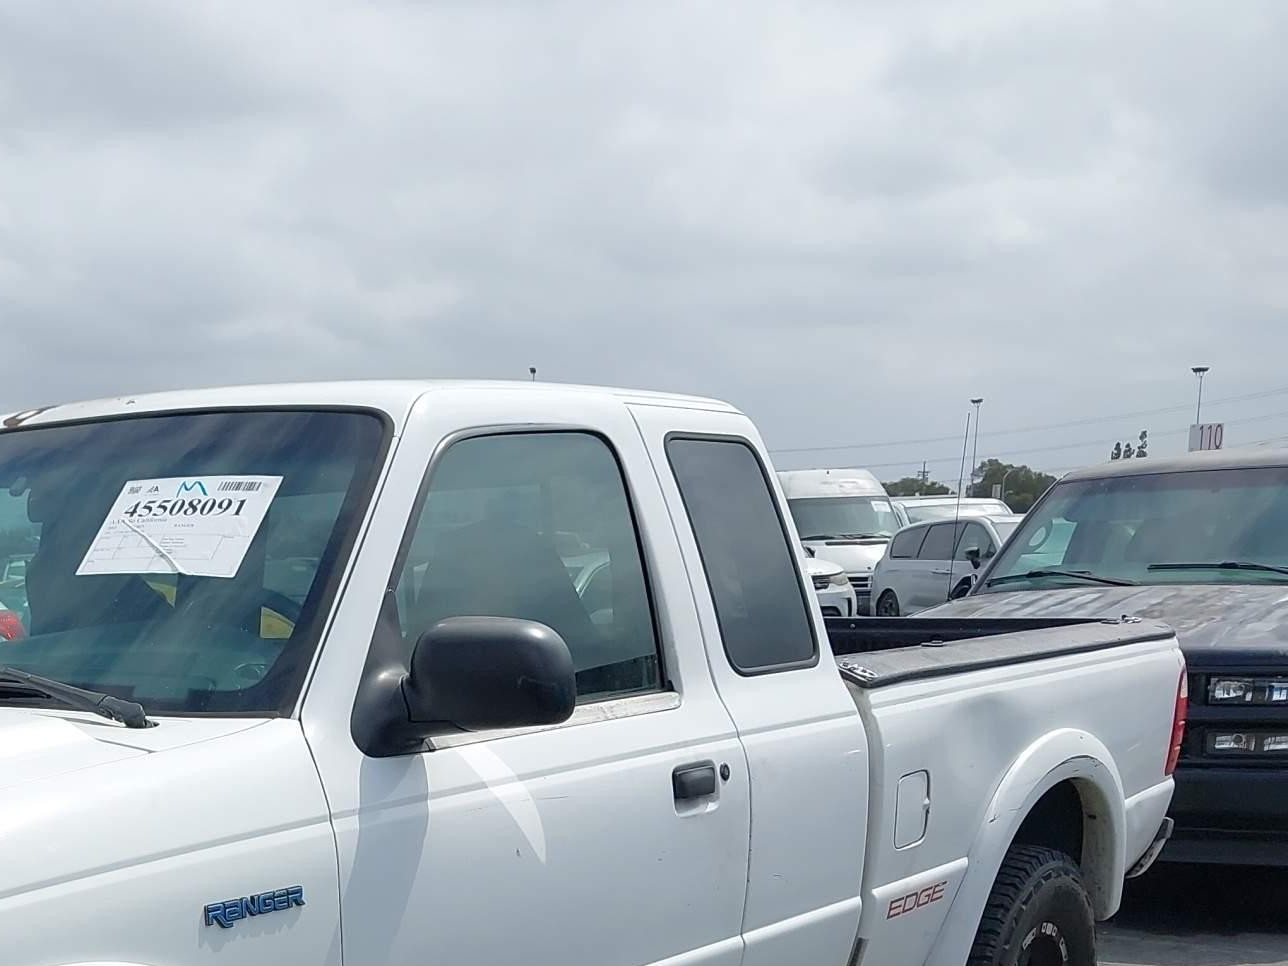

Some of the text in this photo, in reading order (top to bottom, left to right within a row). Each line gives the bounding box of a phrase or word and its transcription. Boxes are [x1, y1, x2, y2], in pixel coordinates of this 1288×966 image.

[123, 498, 248, 517] 45508091
[204, 885, 306, 929] RANGER
[886, 880, 948, 920] EDGE
